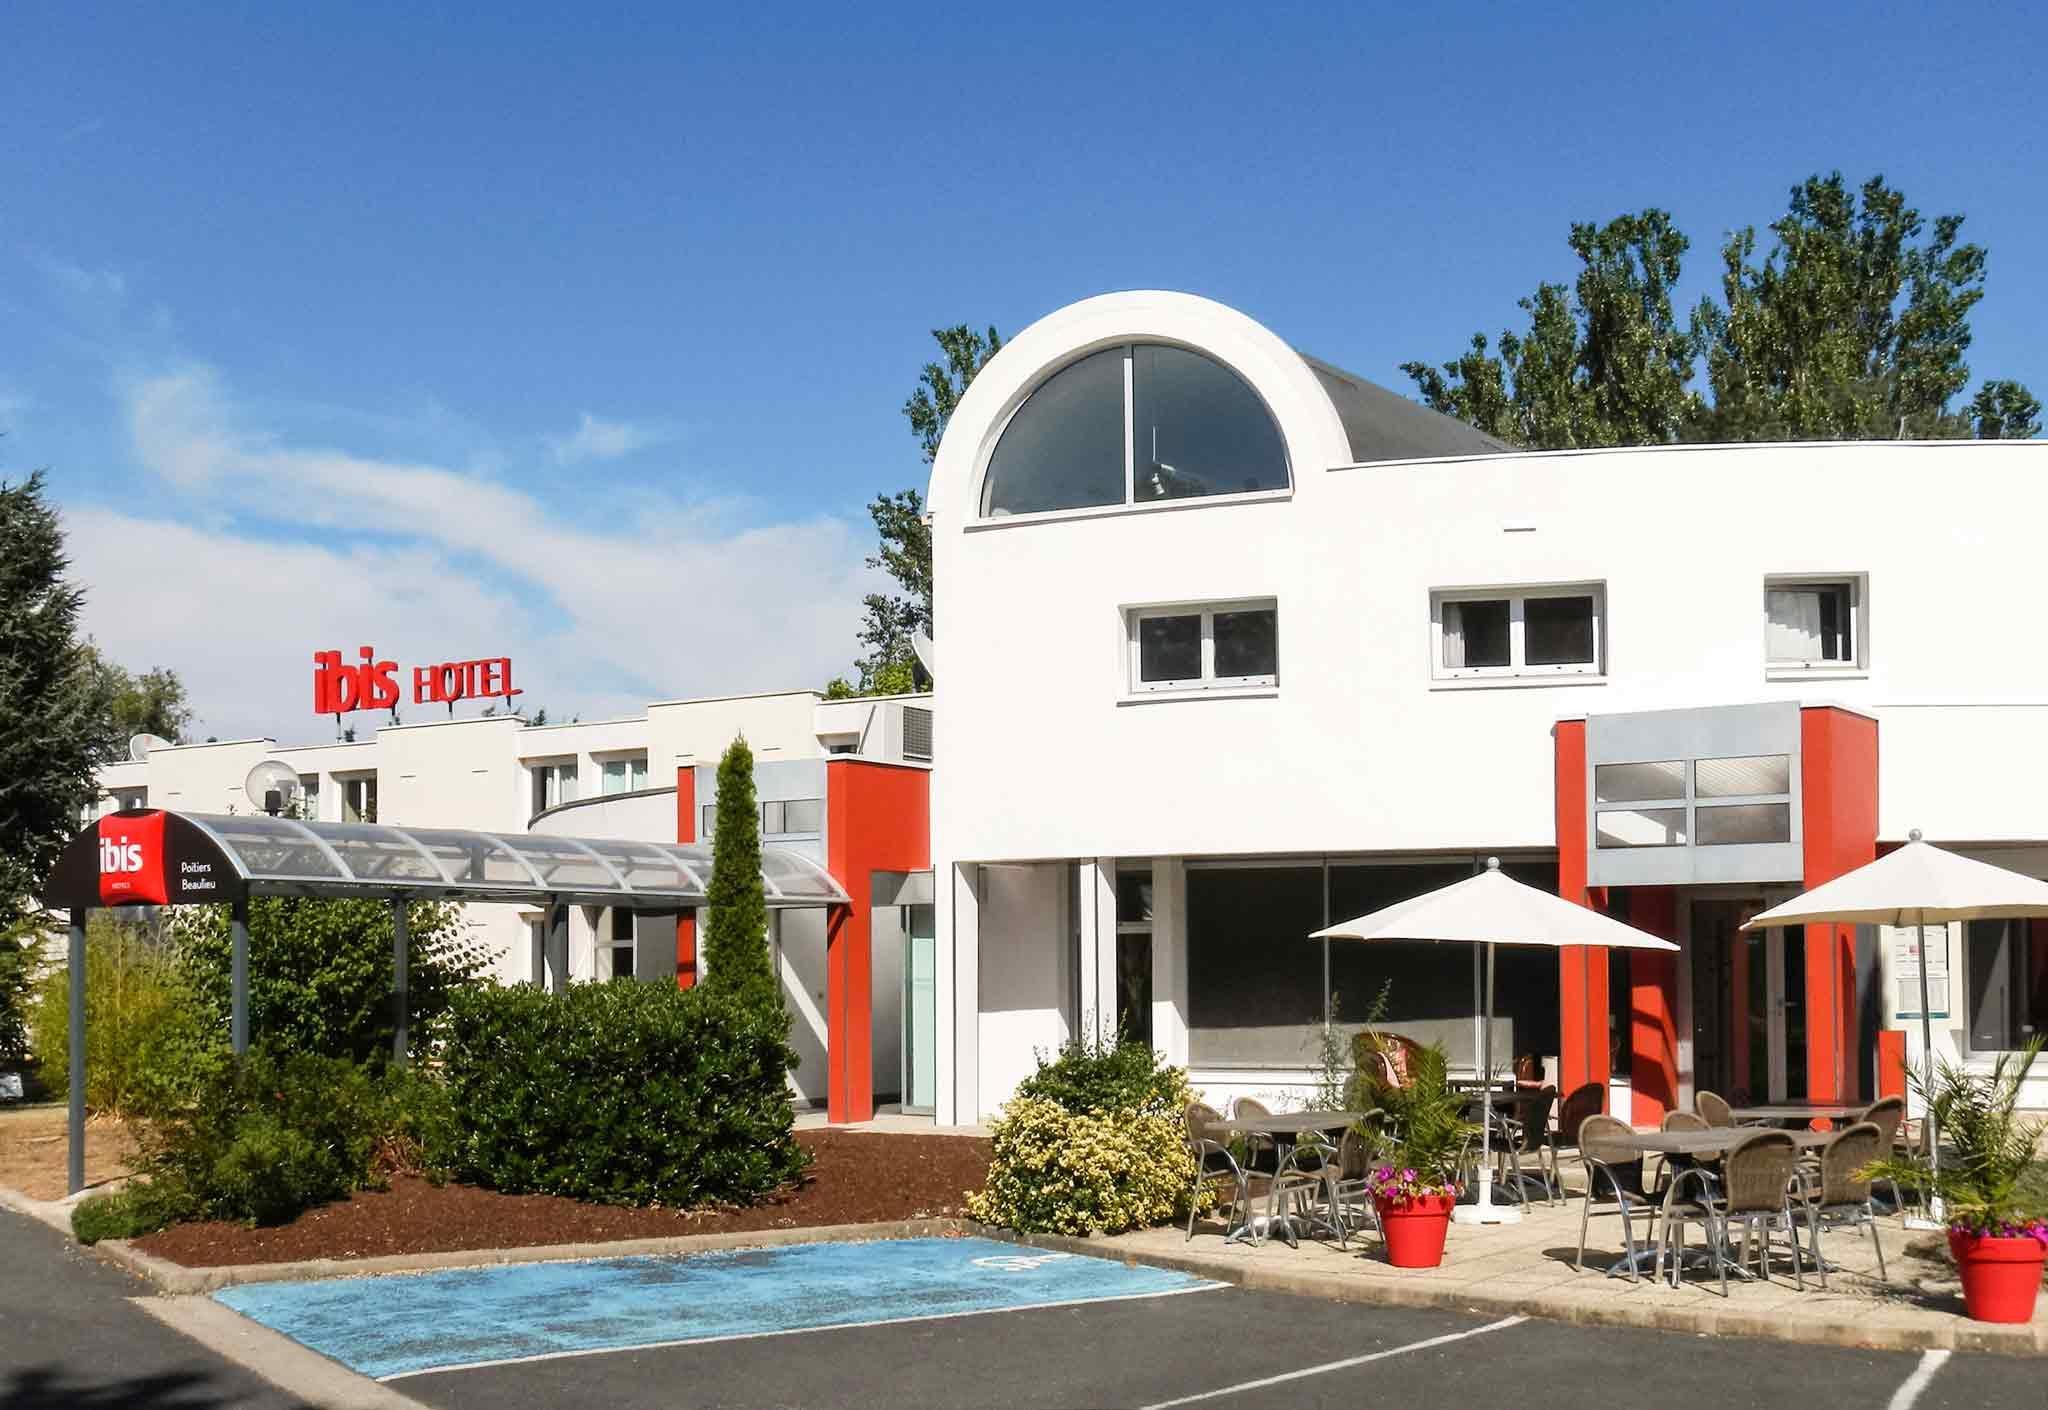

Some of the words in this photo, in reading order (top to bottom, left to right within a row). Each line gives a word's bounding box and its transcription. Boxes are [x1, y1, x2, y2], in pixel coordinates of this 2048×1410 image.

[314, 646, 399, 714] ibis
[413, 657, 523, 704] HOTEL
[99, 836, 143, 873] ibis
[181, 861, 212, 873] Poitiers
[181, 878, 216, 890] Beaulieu
